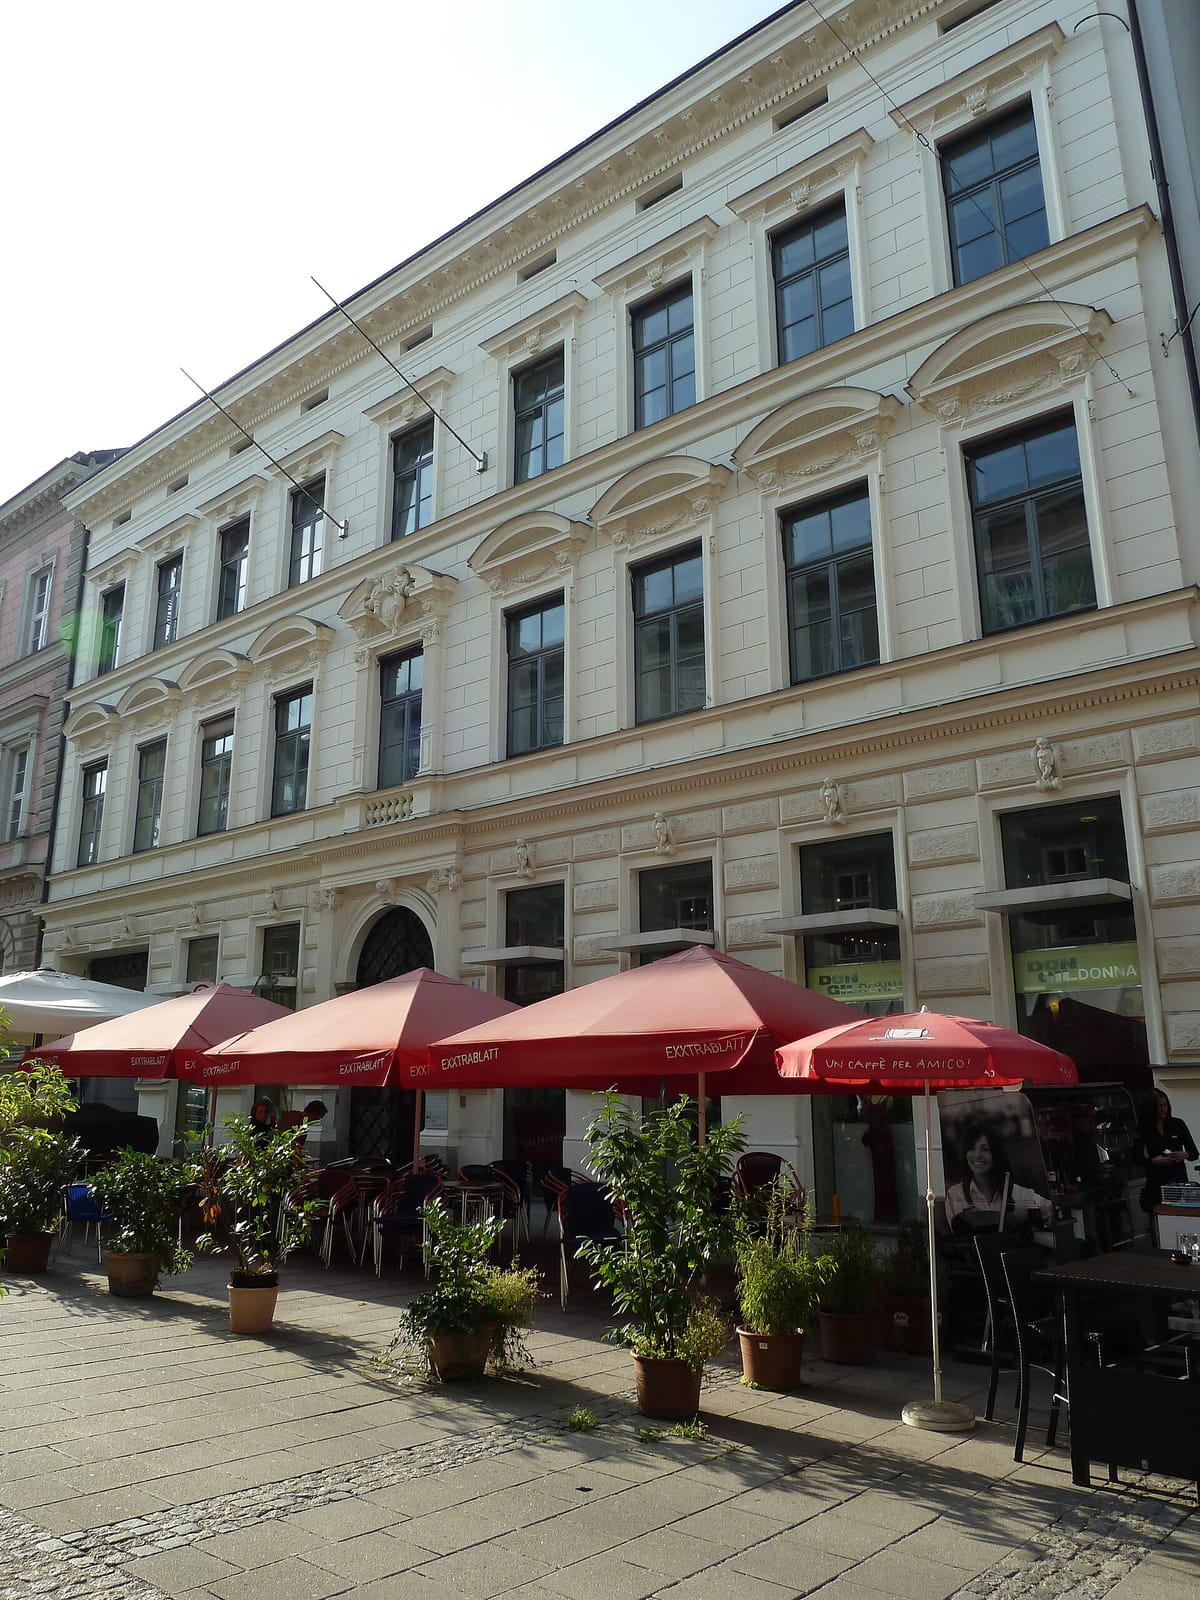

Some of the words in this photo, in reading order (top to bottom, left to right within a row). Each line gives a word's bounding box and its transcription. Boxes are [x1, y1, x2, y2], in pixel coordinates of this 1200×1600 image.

[1027, 957, 1077, 972] DON
[1078, 965, 1137, 980] DONNA
[665, 1036, 746, 1059] EXXTRABLATT
[130, 1056, 166, 1066] EXXTRABLATT
[339, 1057, 385, 1075] EXXTRABLATT
[441, 1048, 499, 1071] EXXTRABLATT
[825, 1059, 844, 1069] UN
[892, 1060, 912, 1069] PER
[916, 1058, 971, 1070] AMICO!
[203, 1060, 241, 1077] EXXTRABLATT
